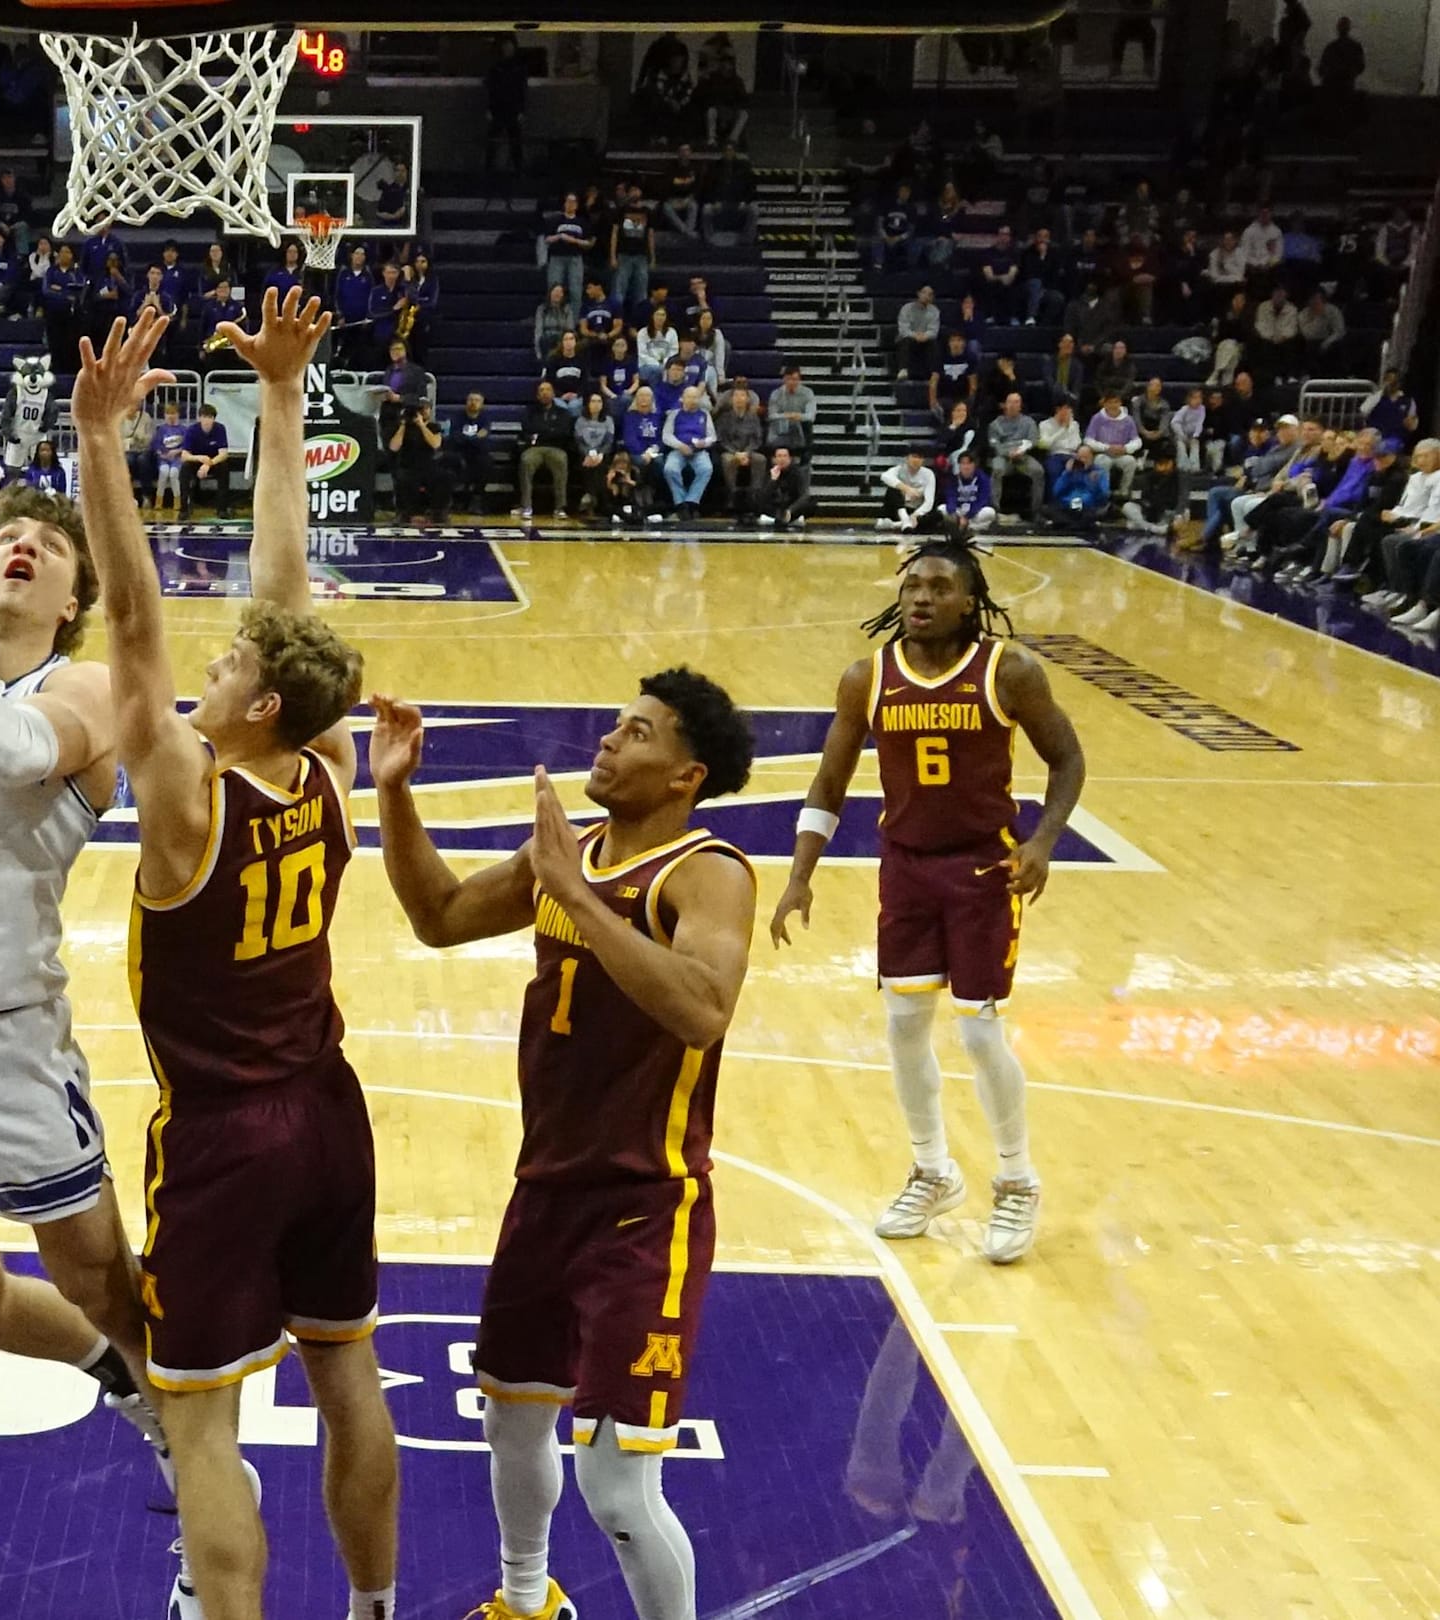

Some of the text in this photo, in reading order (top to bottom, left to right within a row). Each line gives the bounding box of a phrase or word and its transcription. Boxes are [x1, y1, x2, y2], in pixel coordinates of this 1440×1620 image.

[300, 32, 344, 72] 4.8
[306, 363, 327, 393] N
[22, 406, 39, 421] 00
[305, 442, 352, 468] MAN
[306, 481, 361, 520] ijer
[882, 703, 982, 732] MINNESOTA
[915, 736, 951, 785] 6
[249, 795, 323, 855] TYSON
[234, 840, 327, 960] 10
[551, 958, 578, 1035] 1
[631, 1333, 682, 1378] M
